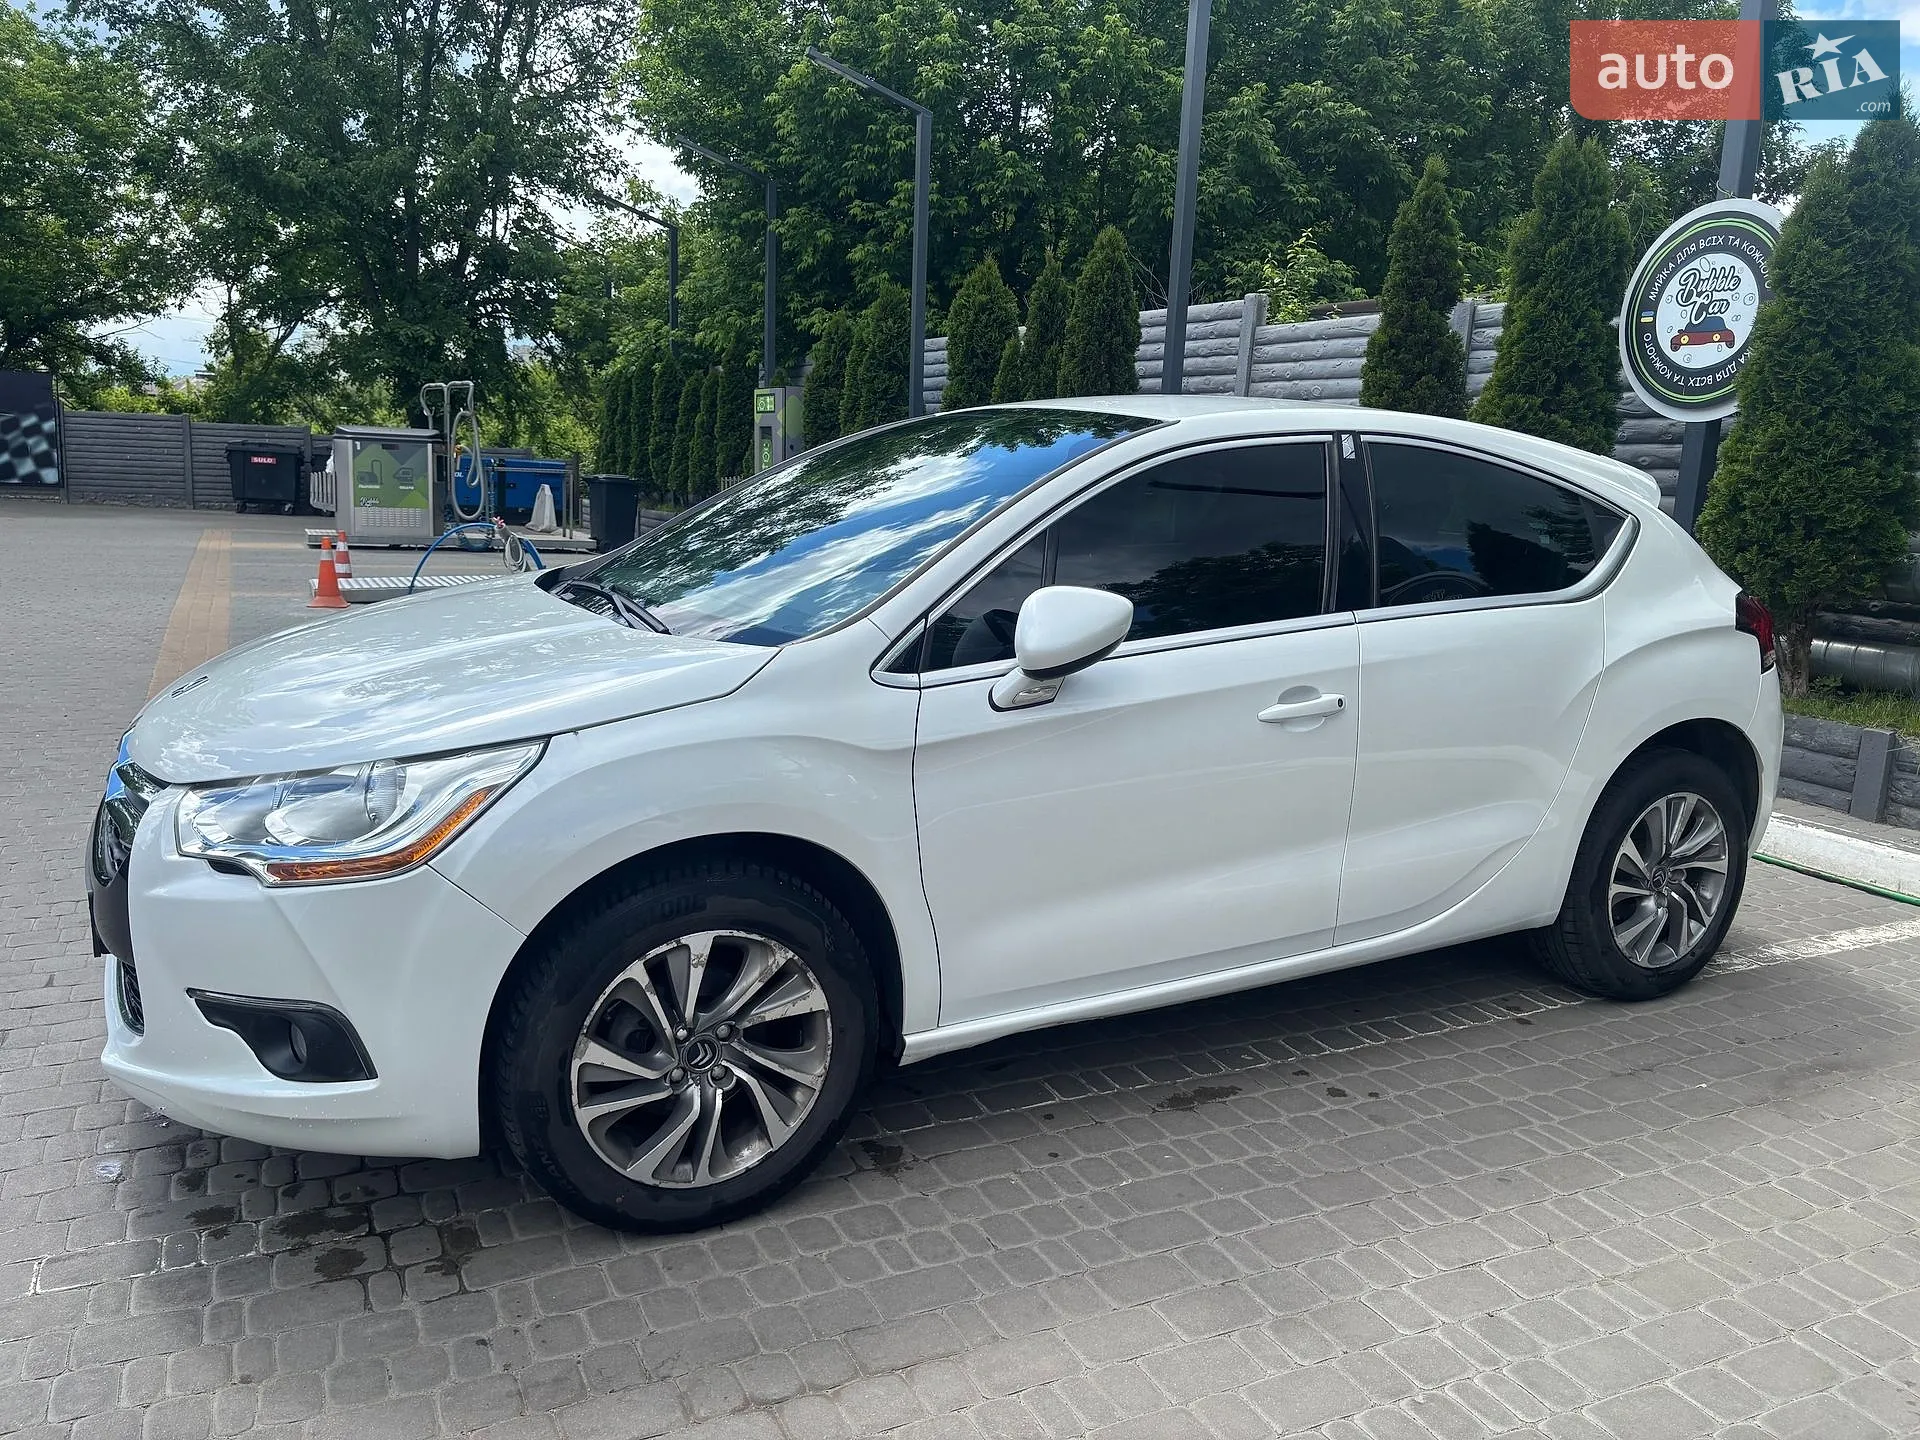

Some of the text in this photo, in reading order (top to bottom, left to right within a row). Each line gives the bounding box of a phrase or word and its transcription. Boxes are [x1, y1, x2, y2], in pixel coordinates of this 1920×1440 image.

[1649, 262, 1675, 301] МИЙКА
[1676, 243, 1697, 264] ДЛЯ
[1699, 235, 1724, 249] ВСІХ
[1728, 235, 1741, 248] ТА
[1677, 266, 1741, 306] Bubble
[1690, 291, 1731, 325] Car
[1643, 332, 1673, 379] КОЖНОГО
